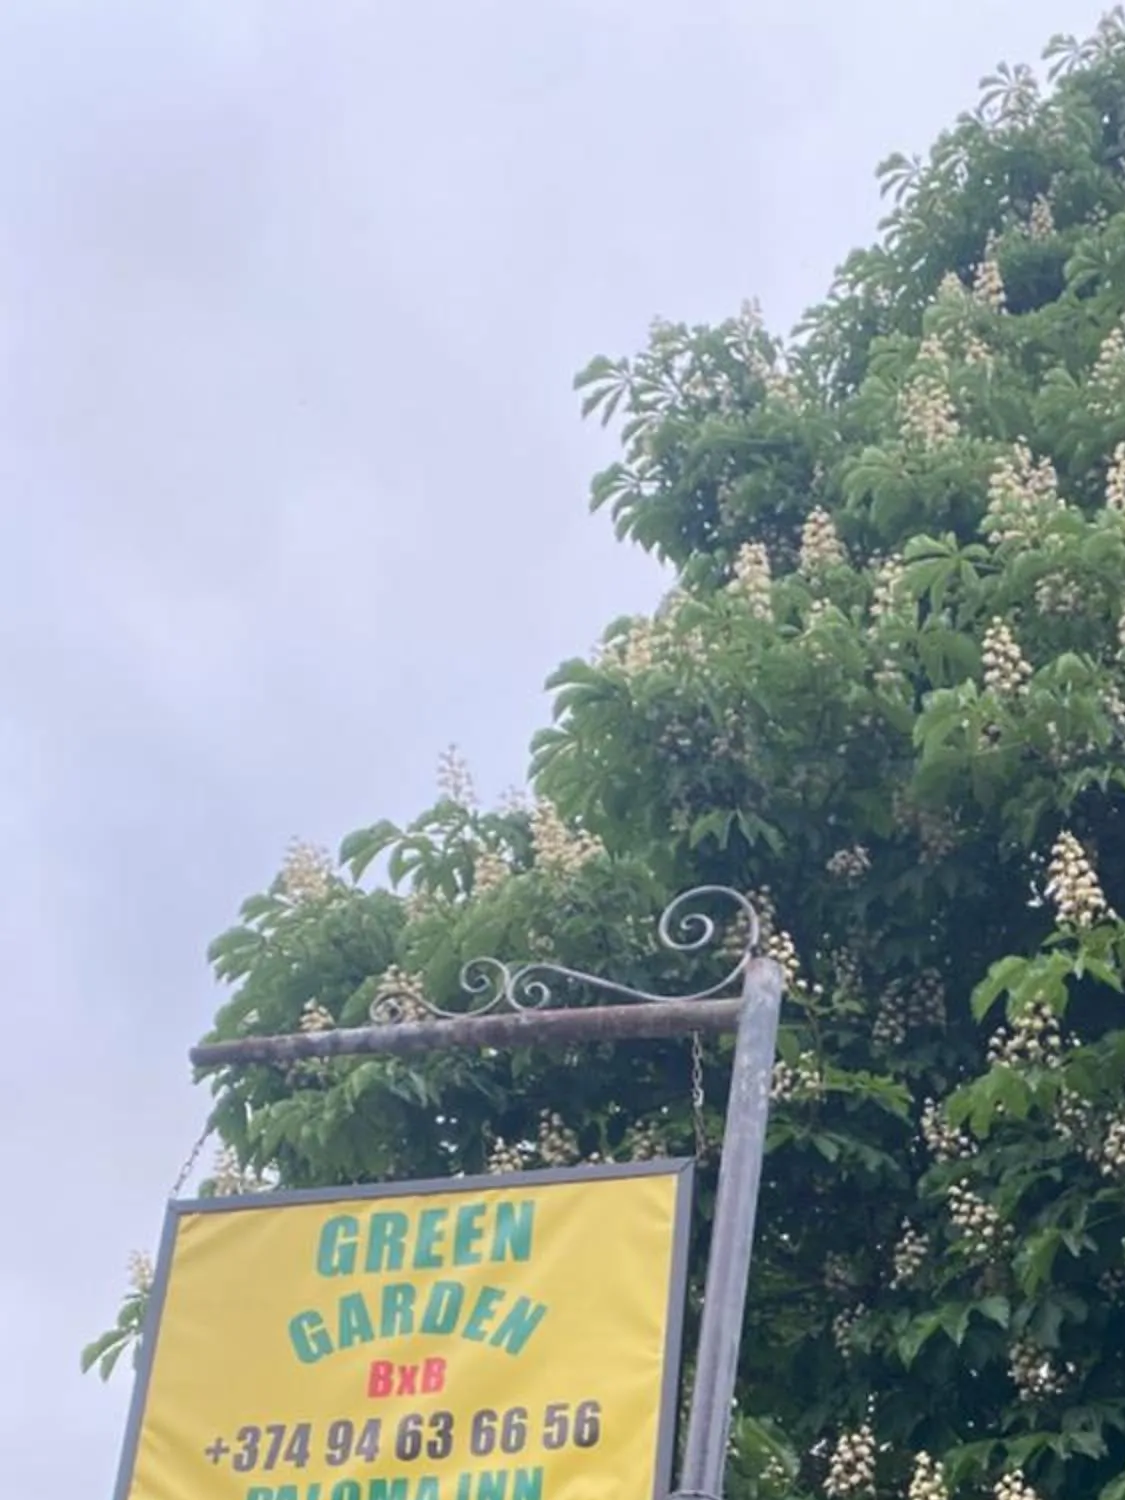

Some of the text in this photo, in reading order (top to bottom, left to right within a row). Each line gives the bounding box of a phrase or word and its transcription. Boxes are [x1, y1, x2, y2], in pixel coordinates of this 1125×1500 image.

[316, 1200, 536, 1278] GREEN
[288, 1280, 548, 1364] GARDEN
[204, 1400, 601, 1473] +374 94 63 66 56
